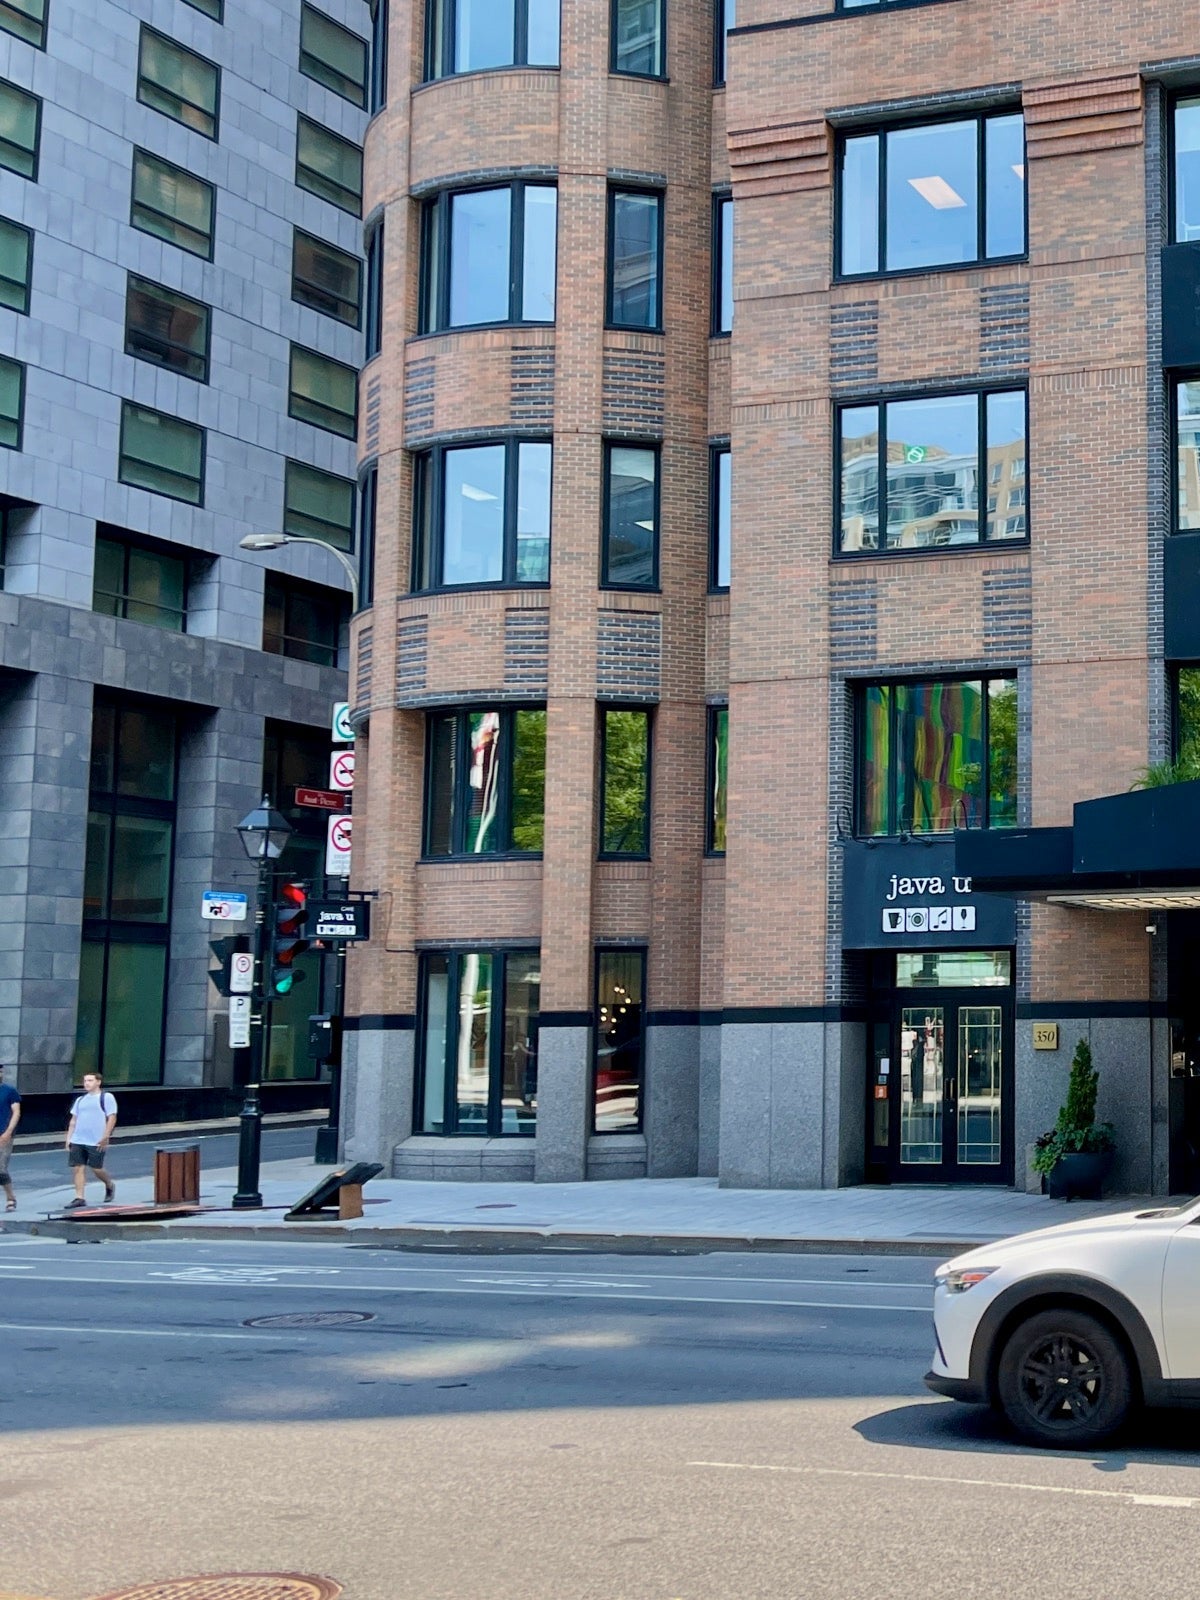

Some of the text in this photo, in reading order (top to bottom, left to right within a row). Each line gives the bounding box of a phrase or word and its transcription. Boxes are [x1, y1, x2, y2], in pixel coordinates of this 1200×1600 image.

[886, 875, 972, 900] java u
[318, 911, 354, 922] java u
[1034, 1030, 1055, 1042] 350
